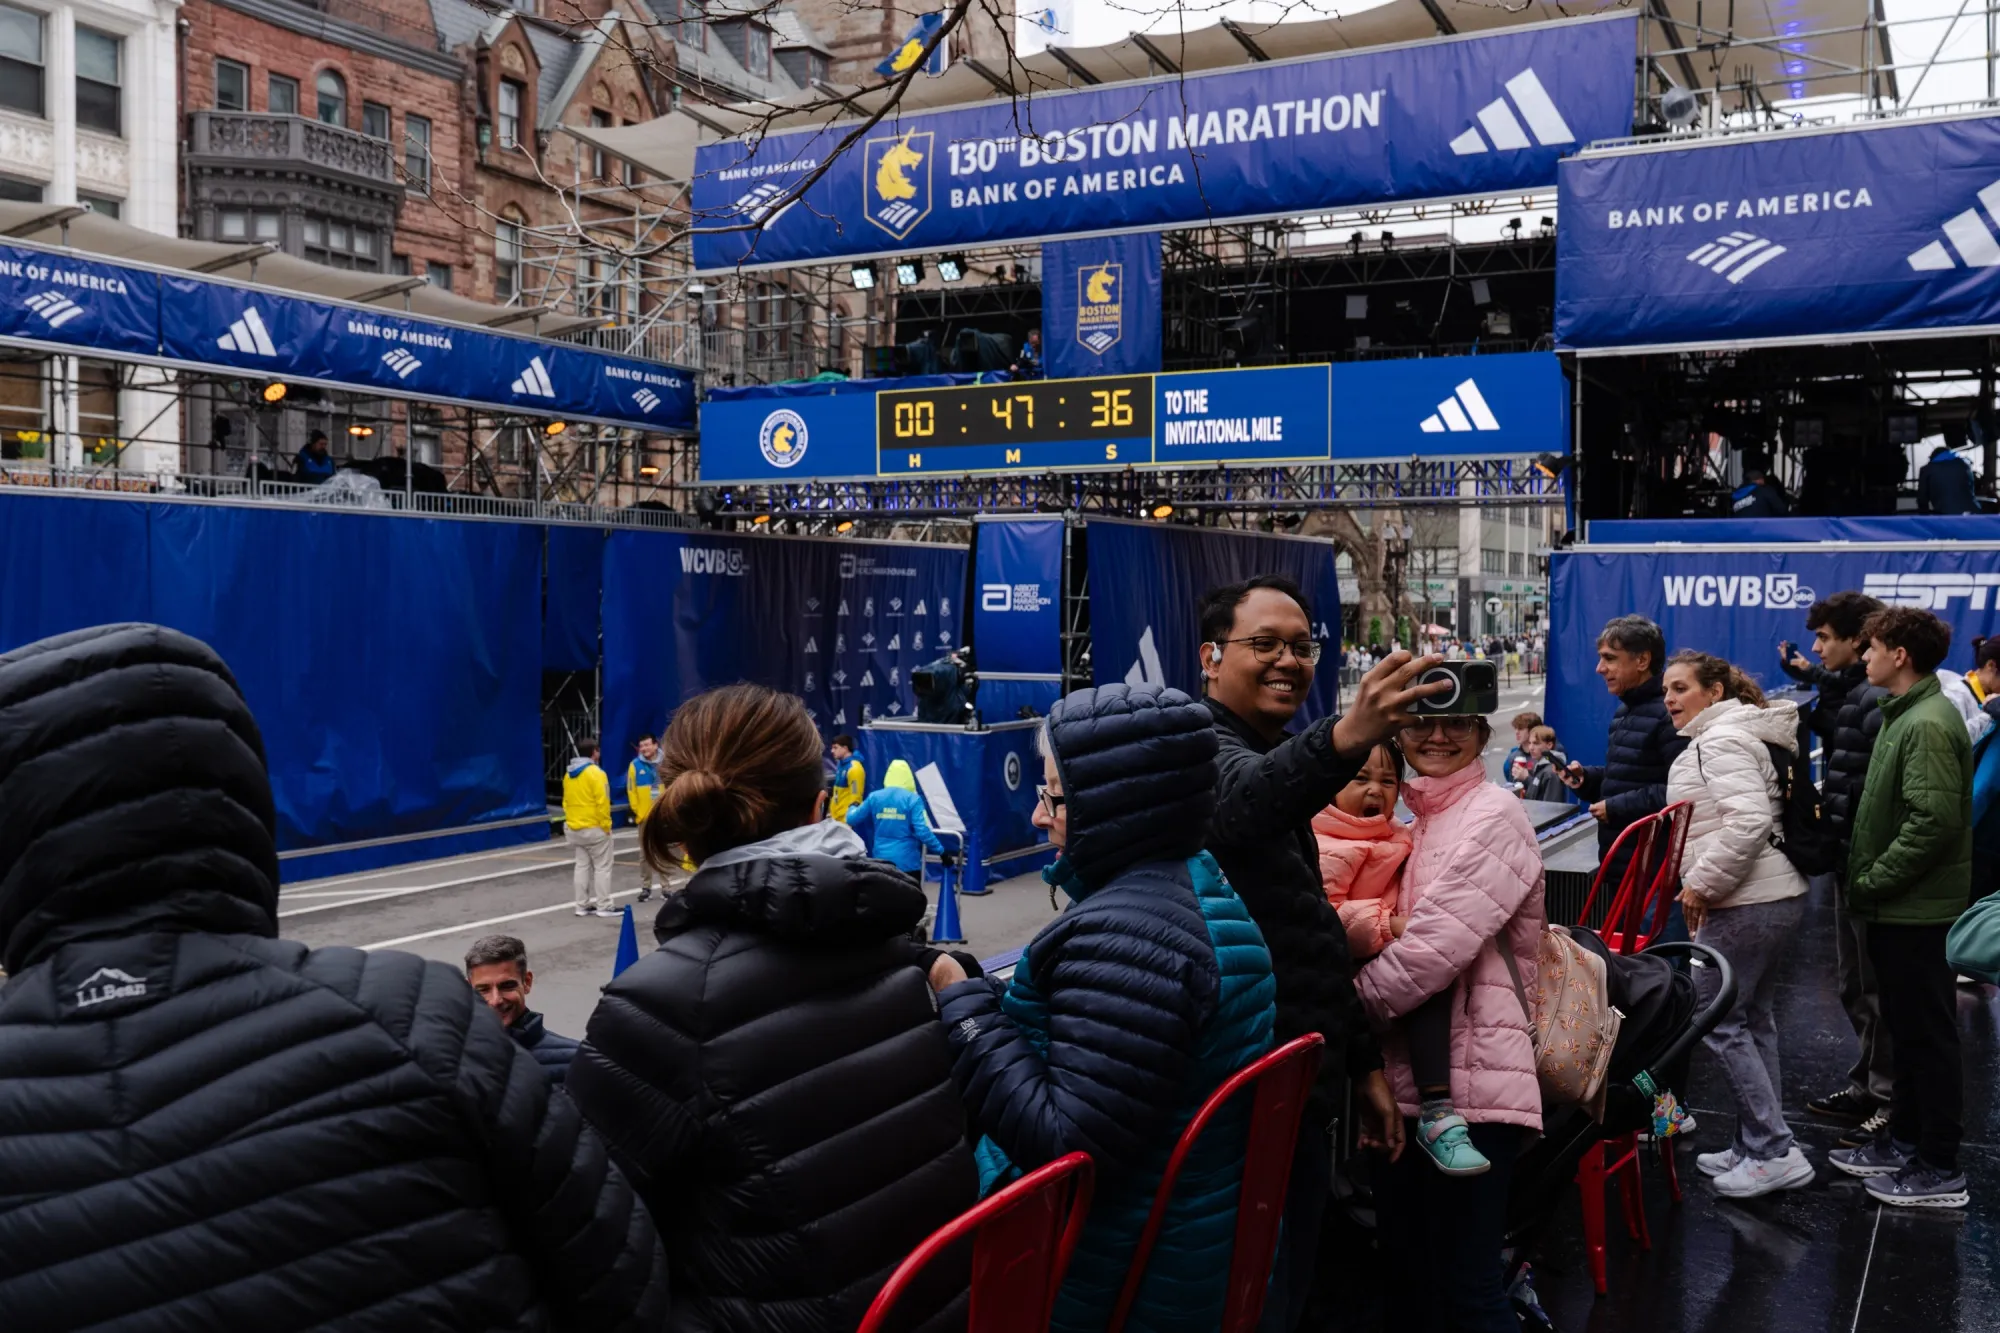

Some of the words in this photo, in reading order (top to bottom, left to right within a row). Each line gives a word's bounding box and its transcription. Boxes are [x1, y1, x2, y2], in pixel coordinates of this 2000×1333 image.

[1020, 119, 1157, 168] BOSTON
[1167, 91, 1380, 150] MARATHON
[719, 169, 749, 181] BANK
[750, 166, 766, 177] OF
[766, 159, 817, 175] AMERICA
[951, 182, 1017, 208] BANK
[1024, 178, 1057, 200] OF
[1063, 163, 1185, 197] AMERICA
[1608, 205, 1684, 229] BANK
[1693, 201, 1729, 222] OF
[1735, 187, 1873, 219] AMERICA
[0, 260, 23, 278] NK
[26, 264, 49, 281] OF
[52, 269, 128, 296] AMERICA
[1079, 304, 1120, 317] BOSTON
[347, 321, 381, 338] BANK
[382, 327, 399, 341] OF
[400, 330, 452, 350] AMERICA
[605, 365, 631, 380] BANK
[631, 370, 643, 382] OF
[644, 373, 681, 389] AMERICA
[895, 401, 934, 437] 00
[992, 394, 1034, 430] 47
[1090, 388, 1133, 427] 36
[1164, 390, 1183, 415] TO
[1184, 388, 1209, 414] THE
[1165, 417, 1250, 446] INVITATIONAL
[1251, 416, 1283, 442] MILE
[908, 453, 922, 468] H
[1006, 448, 1022, 464] M
[1105, 443, 1118, 460] S
[679, 547, 727, 574] WCVB
[1663, 575, 1763, 607] WCVB
